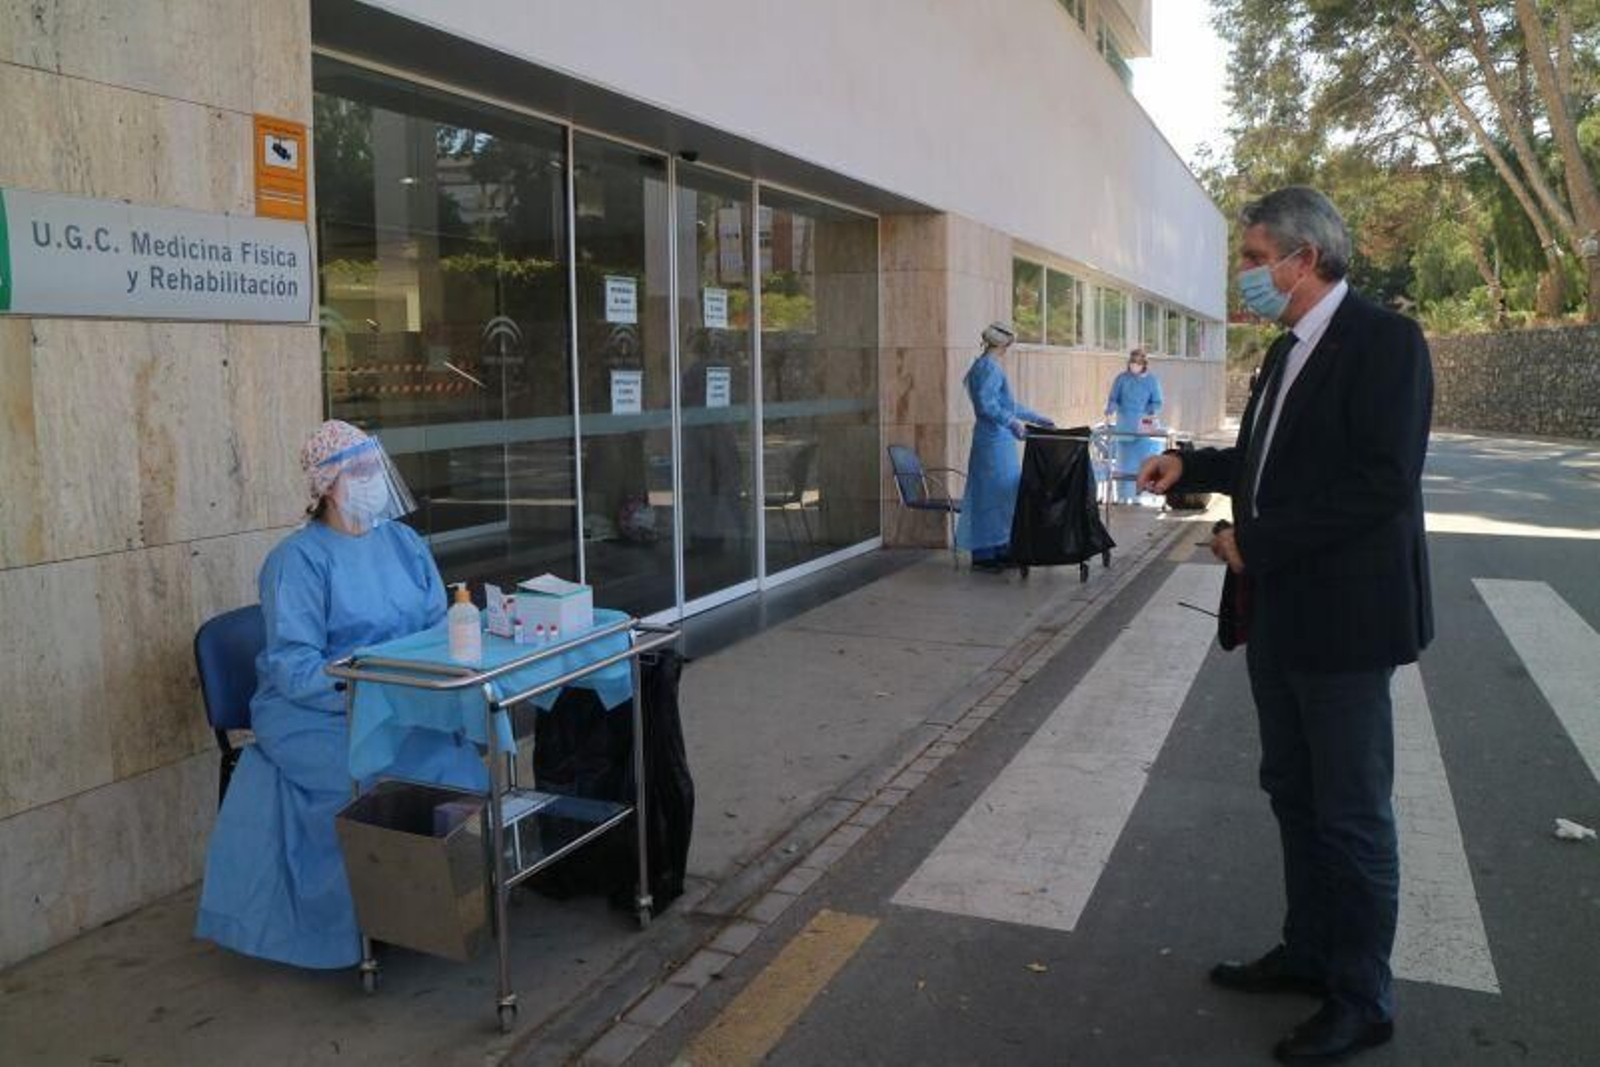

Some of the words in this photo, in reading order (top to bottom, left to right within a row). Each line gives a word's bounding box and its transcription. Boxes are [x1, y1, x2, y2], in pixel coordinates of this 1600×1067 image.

[31, 220, 119, 253] U.G.C.
[131, 231, 232, 263] Medicina
[241, 242, 297, 267] Física
[126, 270, 138, 294] y
[150, 266, 299, 296] Rehabilitación
